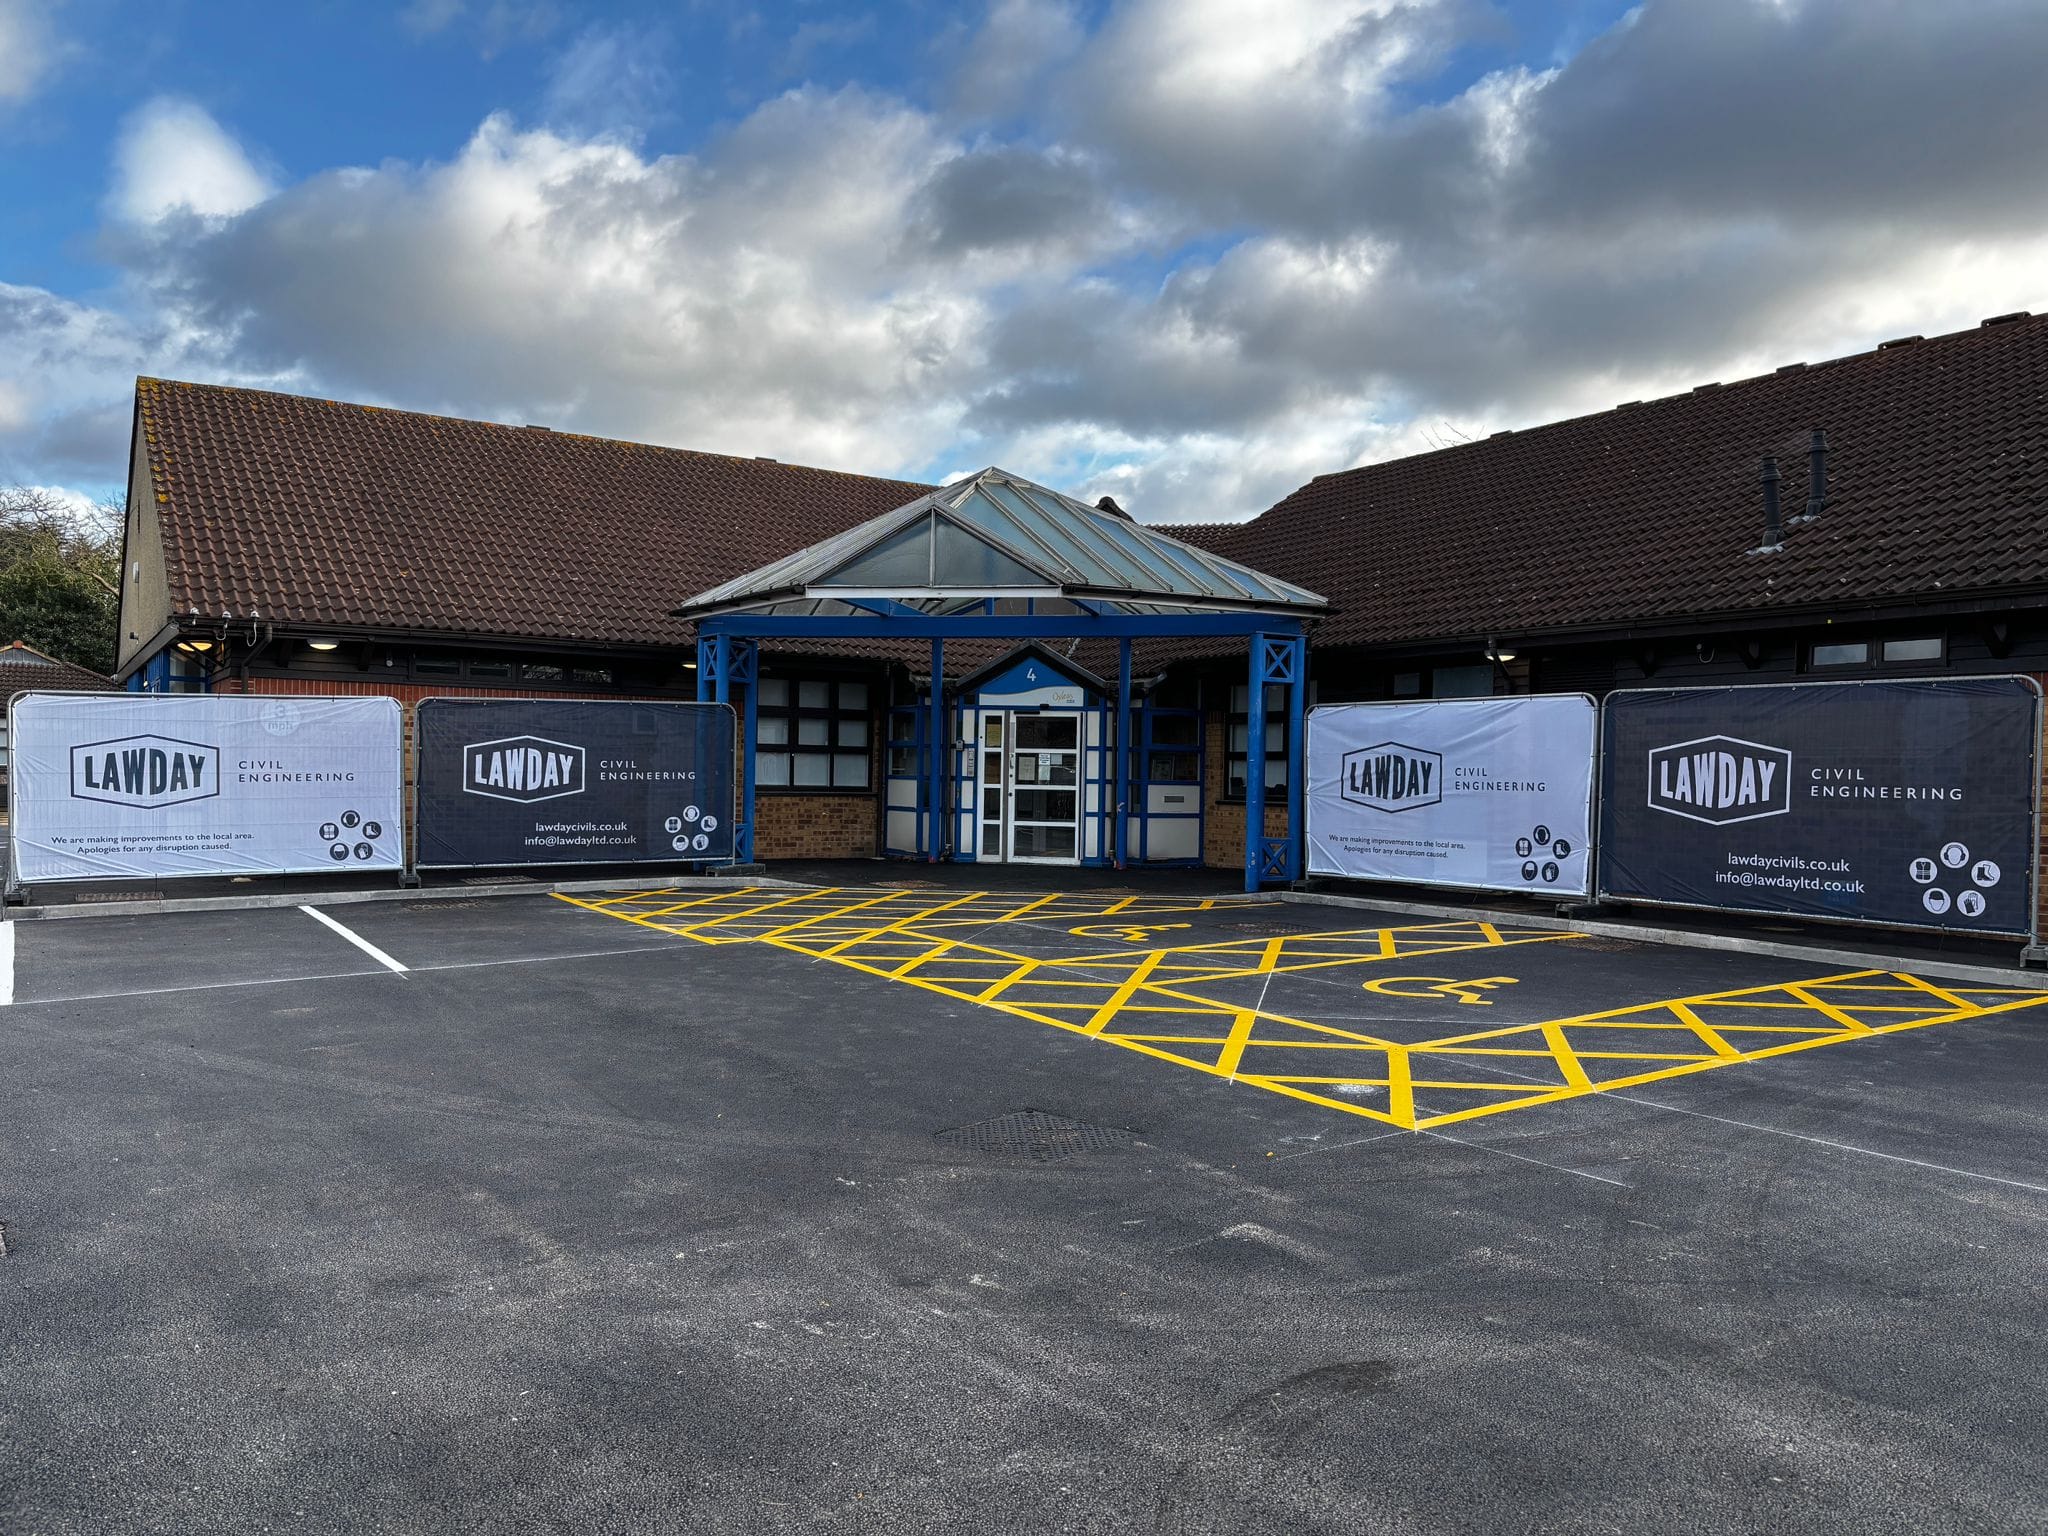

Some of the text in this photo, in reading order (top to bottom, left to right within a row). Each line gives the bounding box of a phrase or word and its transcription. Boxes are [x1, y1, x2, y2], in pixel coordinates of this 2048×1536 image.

[1026, 668, 1037, 682] 4
[268, 720, 293, 732] mph
[238, 760, 283, 770] CIVIL
[475, 747, 574, 791] LAWDAY
[600, 760, 637, 769] CIVIL
[84, 748, 206, 796] LAWDAY
[238, 772, 355, 783] ENGINEERING
[600, 771, 697, 781] ENGINEERING
[1350, 754, 1433, 800] LAWDAY
[1455, 767, 1488, 777] CIVIL
[1811, 768, 1865, 781] CIVIL
[1660, 751, 1777, 809] LAWDAY
[1455, 781, 1546, 792] ENGINEERING
[1810, 785, 1963, 800] ENGINEERING
[535, 821, 628, 833] lawdaycivils.co.uk
[51, 836, 67, 845] We
[87, 835, 118, 845] making
[121, 834, 183, 844] improvements
[197, 833, 211, 841] the
[525, 835, 637, 847] info@lawdayltd.co.uk
[1350, 835, 1371, 845] making
[1371, 836, 1414, 847] improvements
[1423, 839, 1434, 848] the
[1435, 840, 1449, 849] local
[1451, 842, 1466, 850] area.
[77, 843, 232, 855] Apologies for any disruption caused.
[1343, 844, 1448, 859] Apologies for any disruption caused.
[1727, 852, 1851, 873] lawdaycivils.co.uk
[1715, 870, 1865, 894] info@lawdayltd.co.uk
